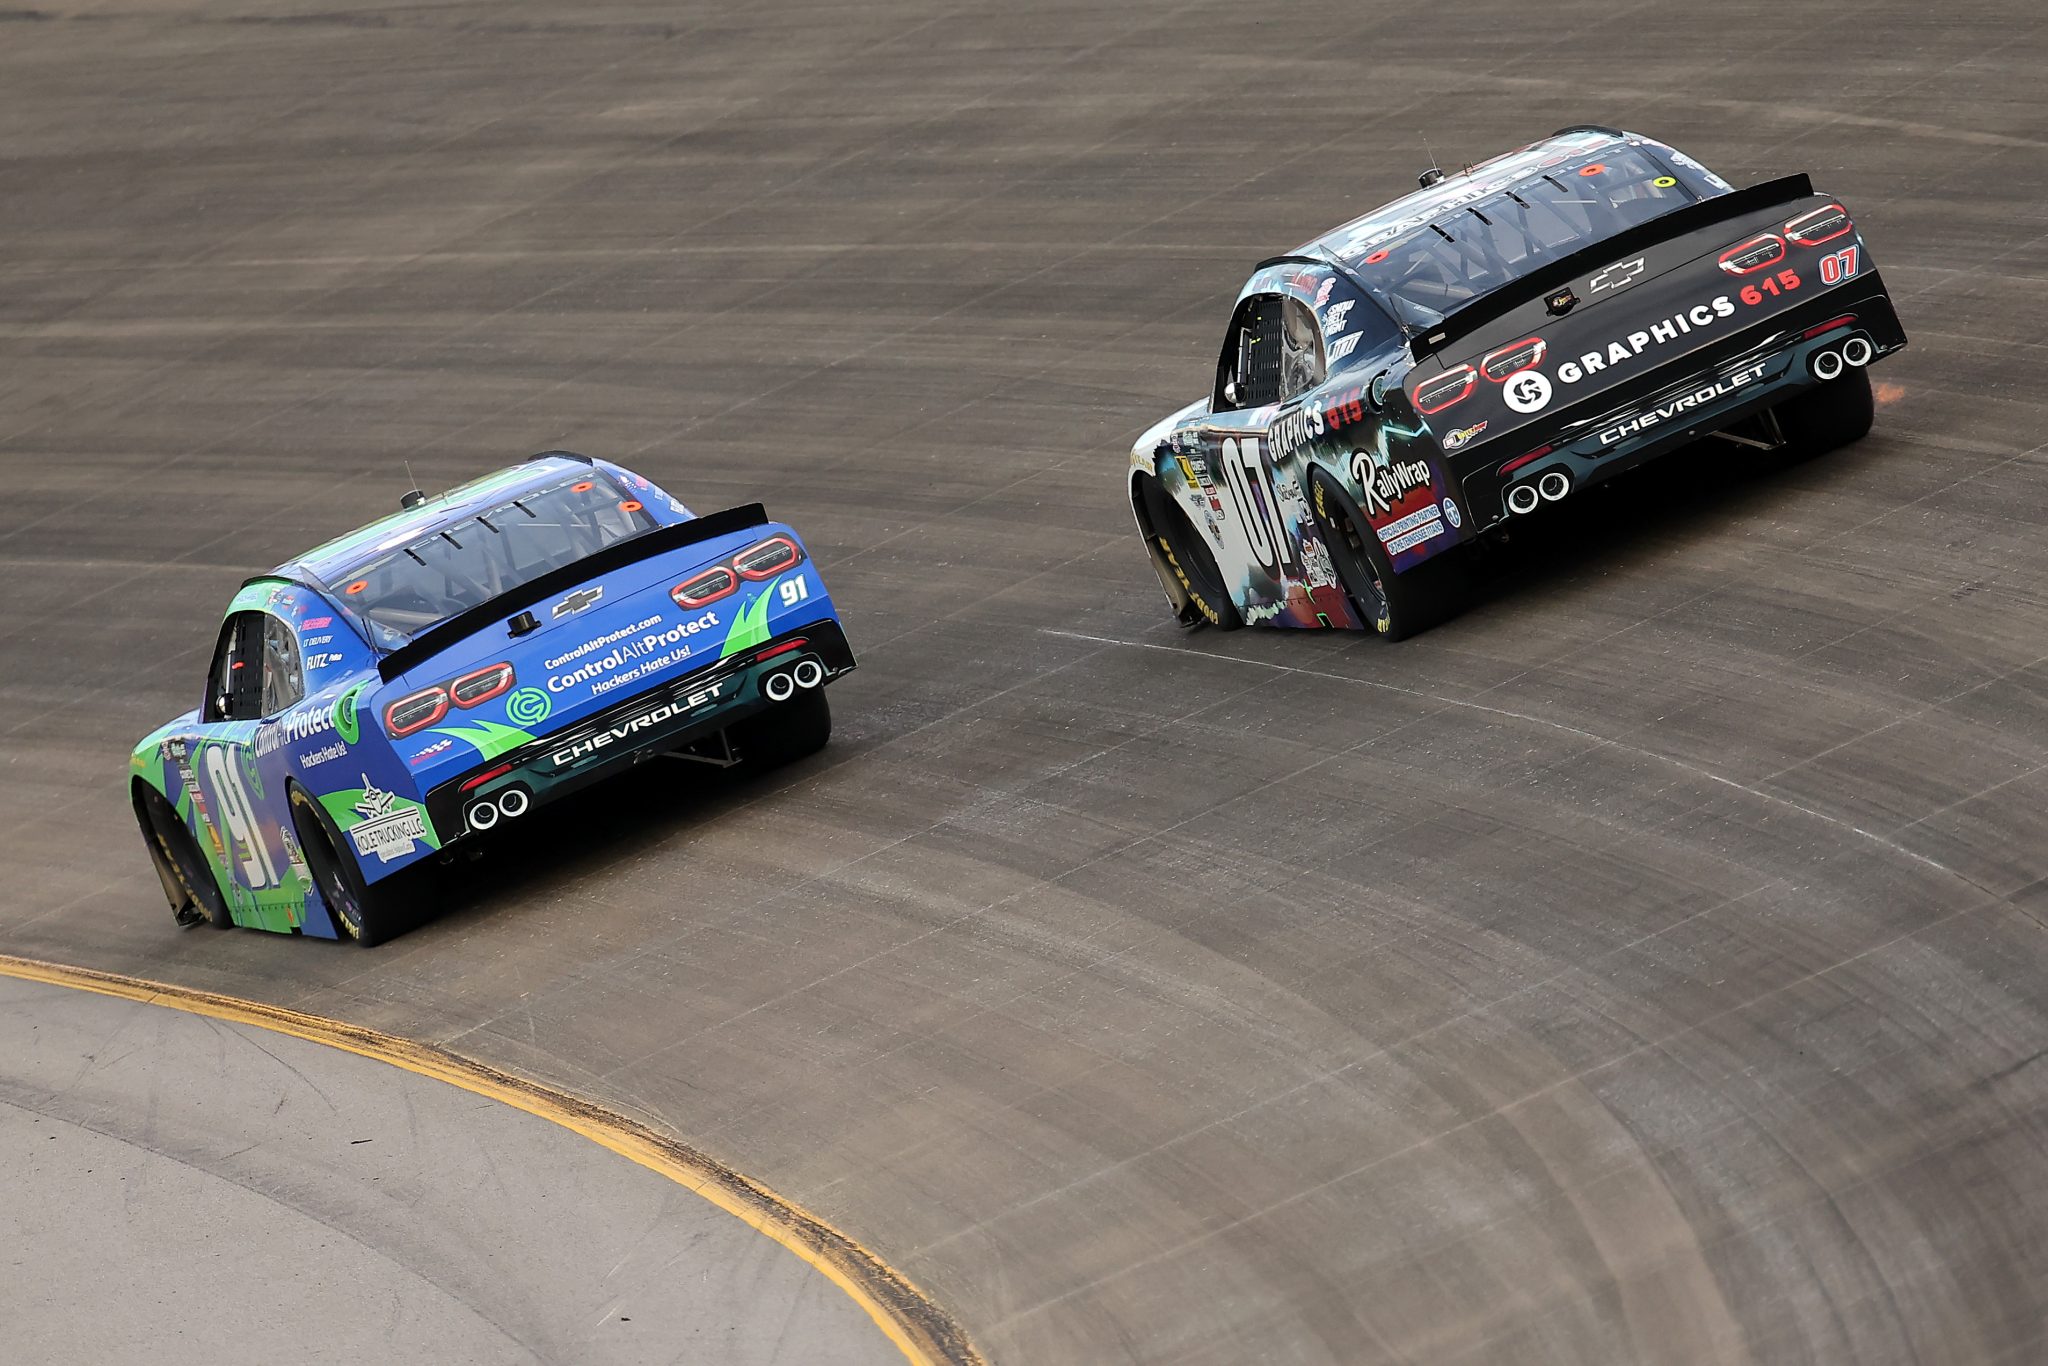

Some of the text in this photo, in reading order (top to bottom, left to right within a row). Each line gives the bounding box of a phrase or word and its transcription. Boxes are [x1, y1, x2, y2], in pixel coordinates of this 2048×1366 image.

[1819, 244, 1860, 286] 07
[1557, 269, 1800, 384] GRAPHICS 615
[1268, 400, 1325, 463] GRAPHICS
[1599, 362, 1767, 446] CHEVROLET
[1222, 437, 1292, 567] 07
[1352, 452, 1431, 515] RallyWrap
[780, 573, 809, 608] 91
[306, 653, 329, 671] FLITZ
[544, 614, 663, 671] ControlAltProtect.com
[547, 611, 720, 693] ControlAltProtect
[591, 645, 692, 696] Hackers Hate Us!
[552, 682, 724, 767] CHEVROLET
[300, 750, 325, 769] Hackers
[206, 741, 280, 888] 91
